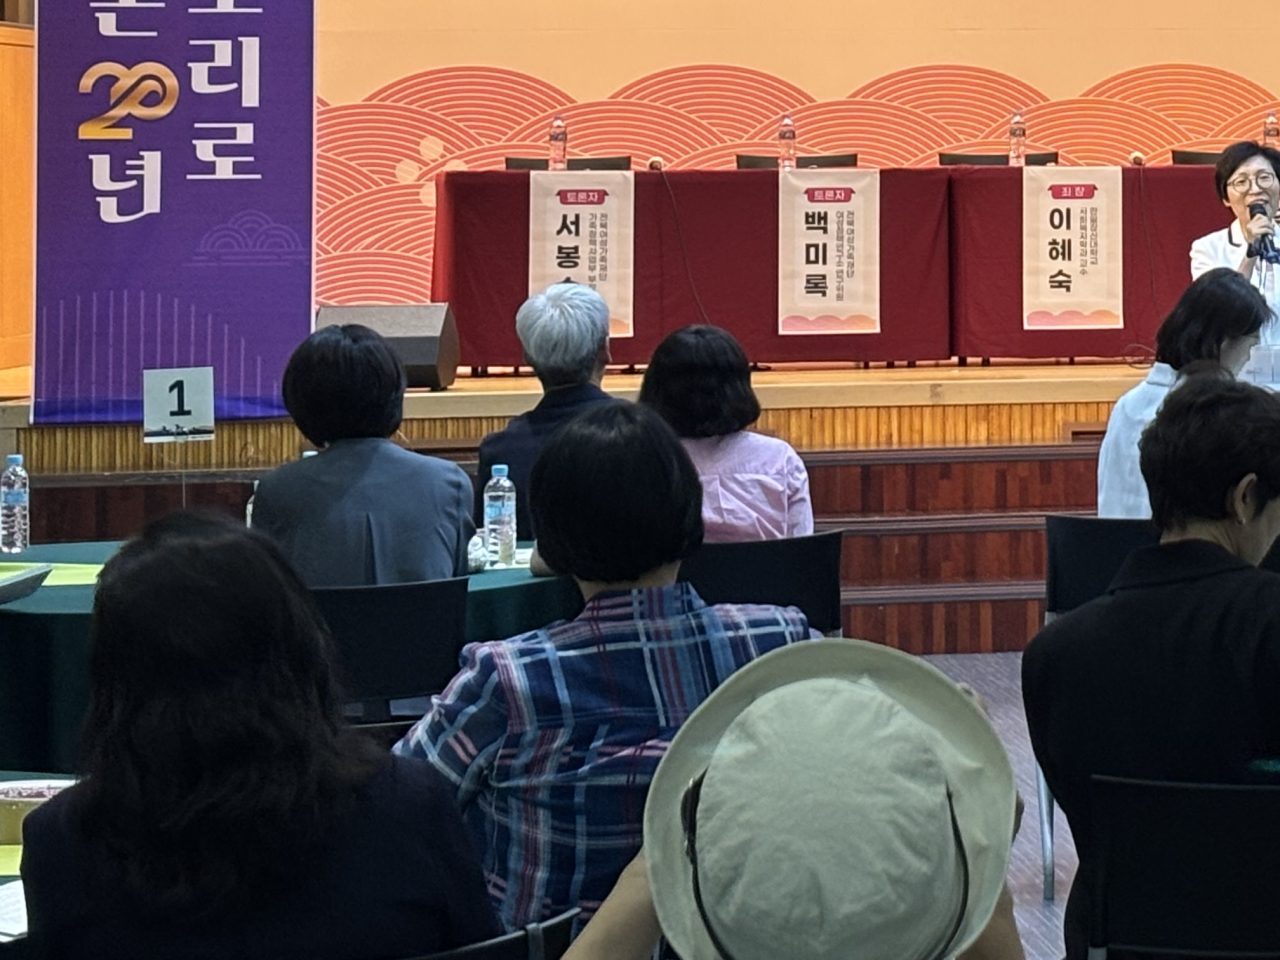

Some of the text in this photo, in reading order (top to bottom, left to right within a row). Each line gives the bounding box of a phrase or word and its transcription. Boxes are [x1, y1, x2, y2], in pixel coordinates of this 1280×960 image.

[566, 192, 599, 203] 토론자
[813, 190, 845, 201] 토론자
[556, 213, 580, 283] 서봉
[804, 211, 829, 297] 백미록
[1049, 207, 1072, 293] 이혜숙
[168, 379, 192, 417] 1
